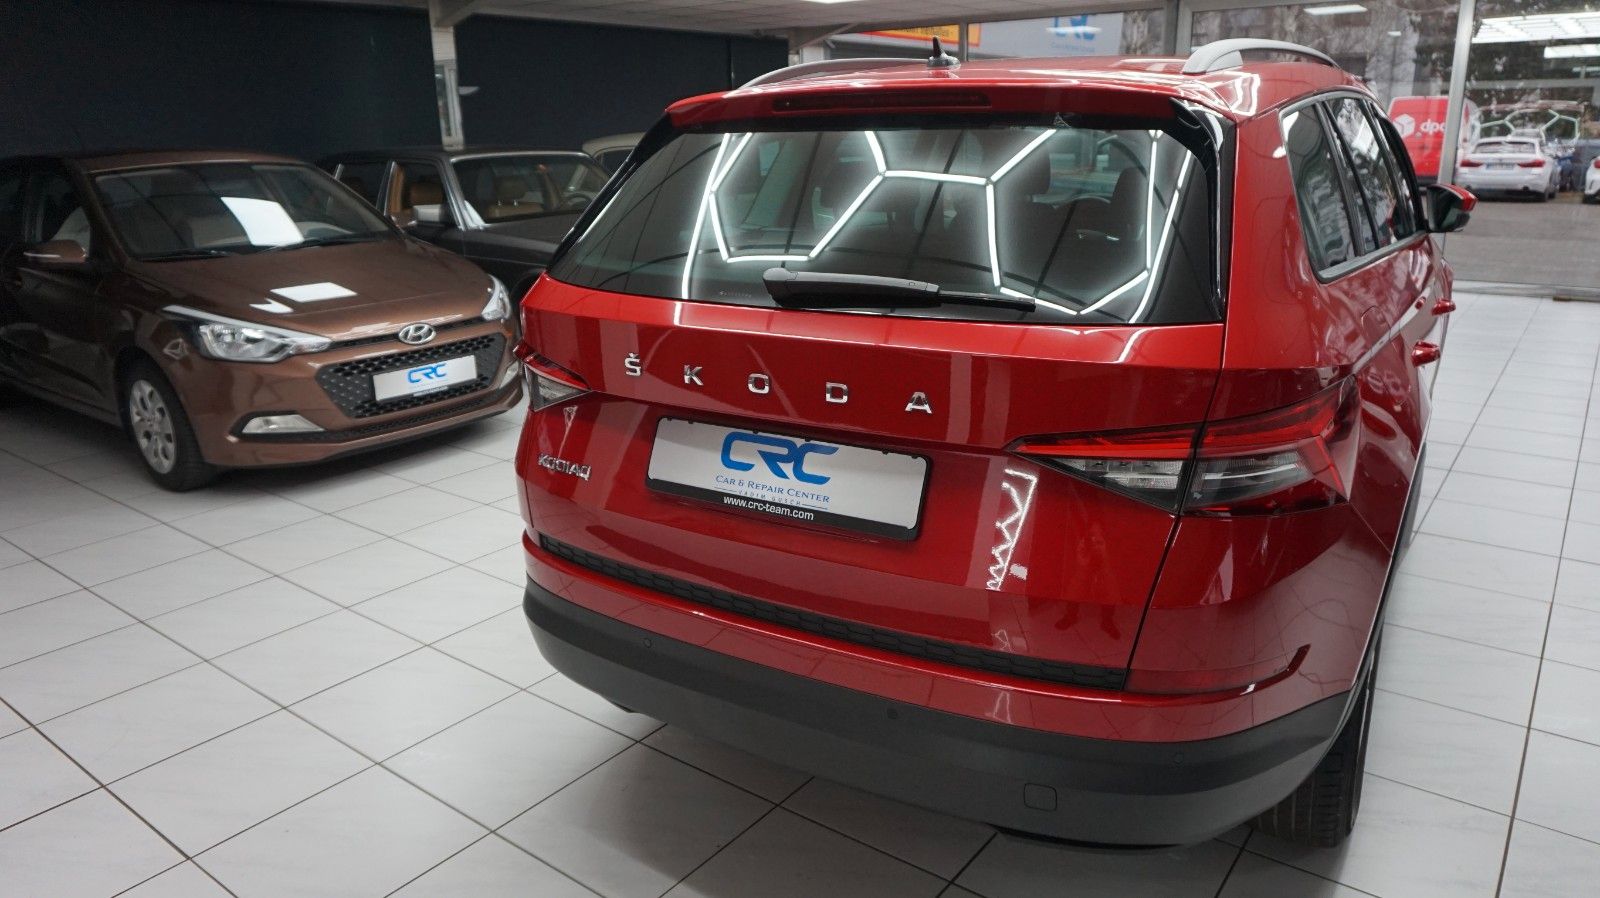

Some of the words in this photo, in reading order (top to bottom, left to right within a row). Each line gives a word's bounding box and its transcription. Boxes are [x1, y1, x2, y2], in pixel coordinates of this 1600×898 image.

[408, 363, 447, 383] CRC
[624, 352, 933, 414] ŠKODA
[538, 453, 591, 481] KODIAQ
[721, 431, 839, 485] CRC
[723, 496, 814, 520] www.crc-team.com
